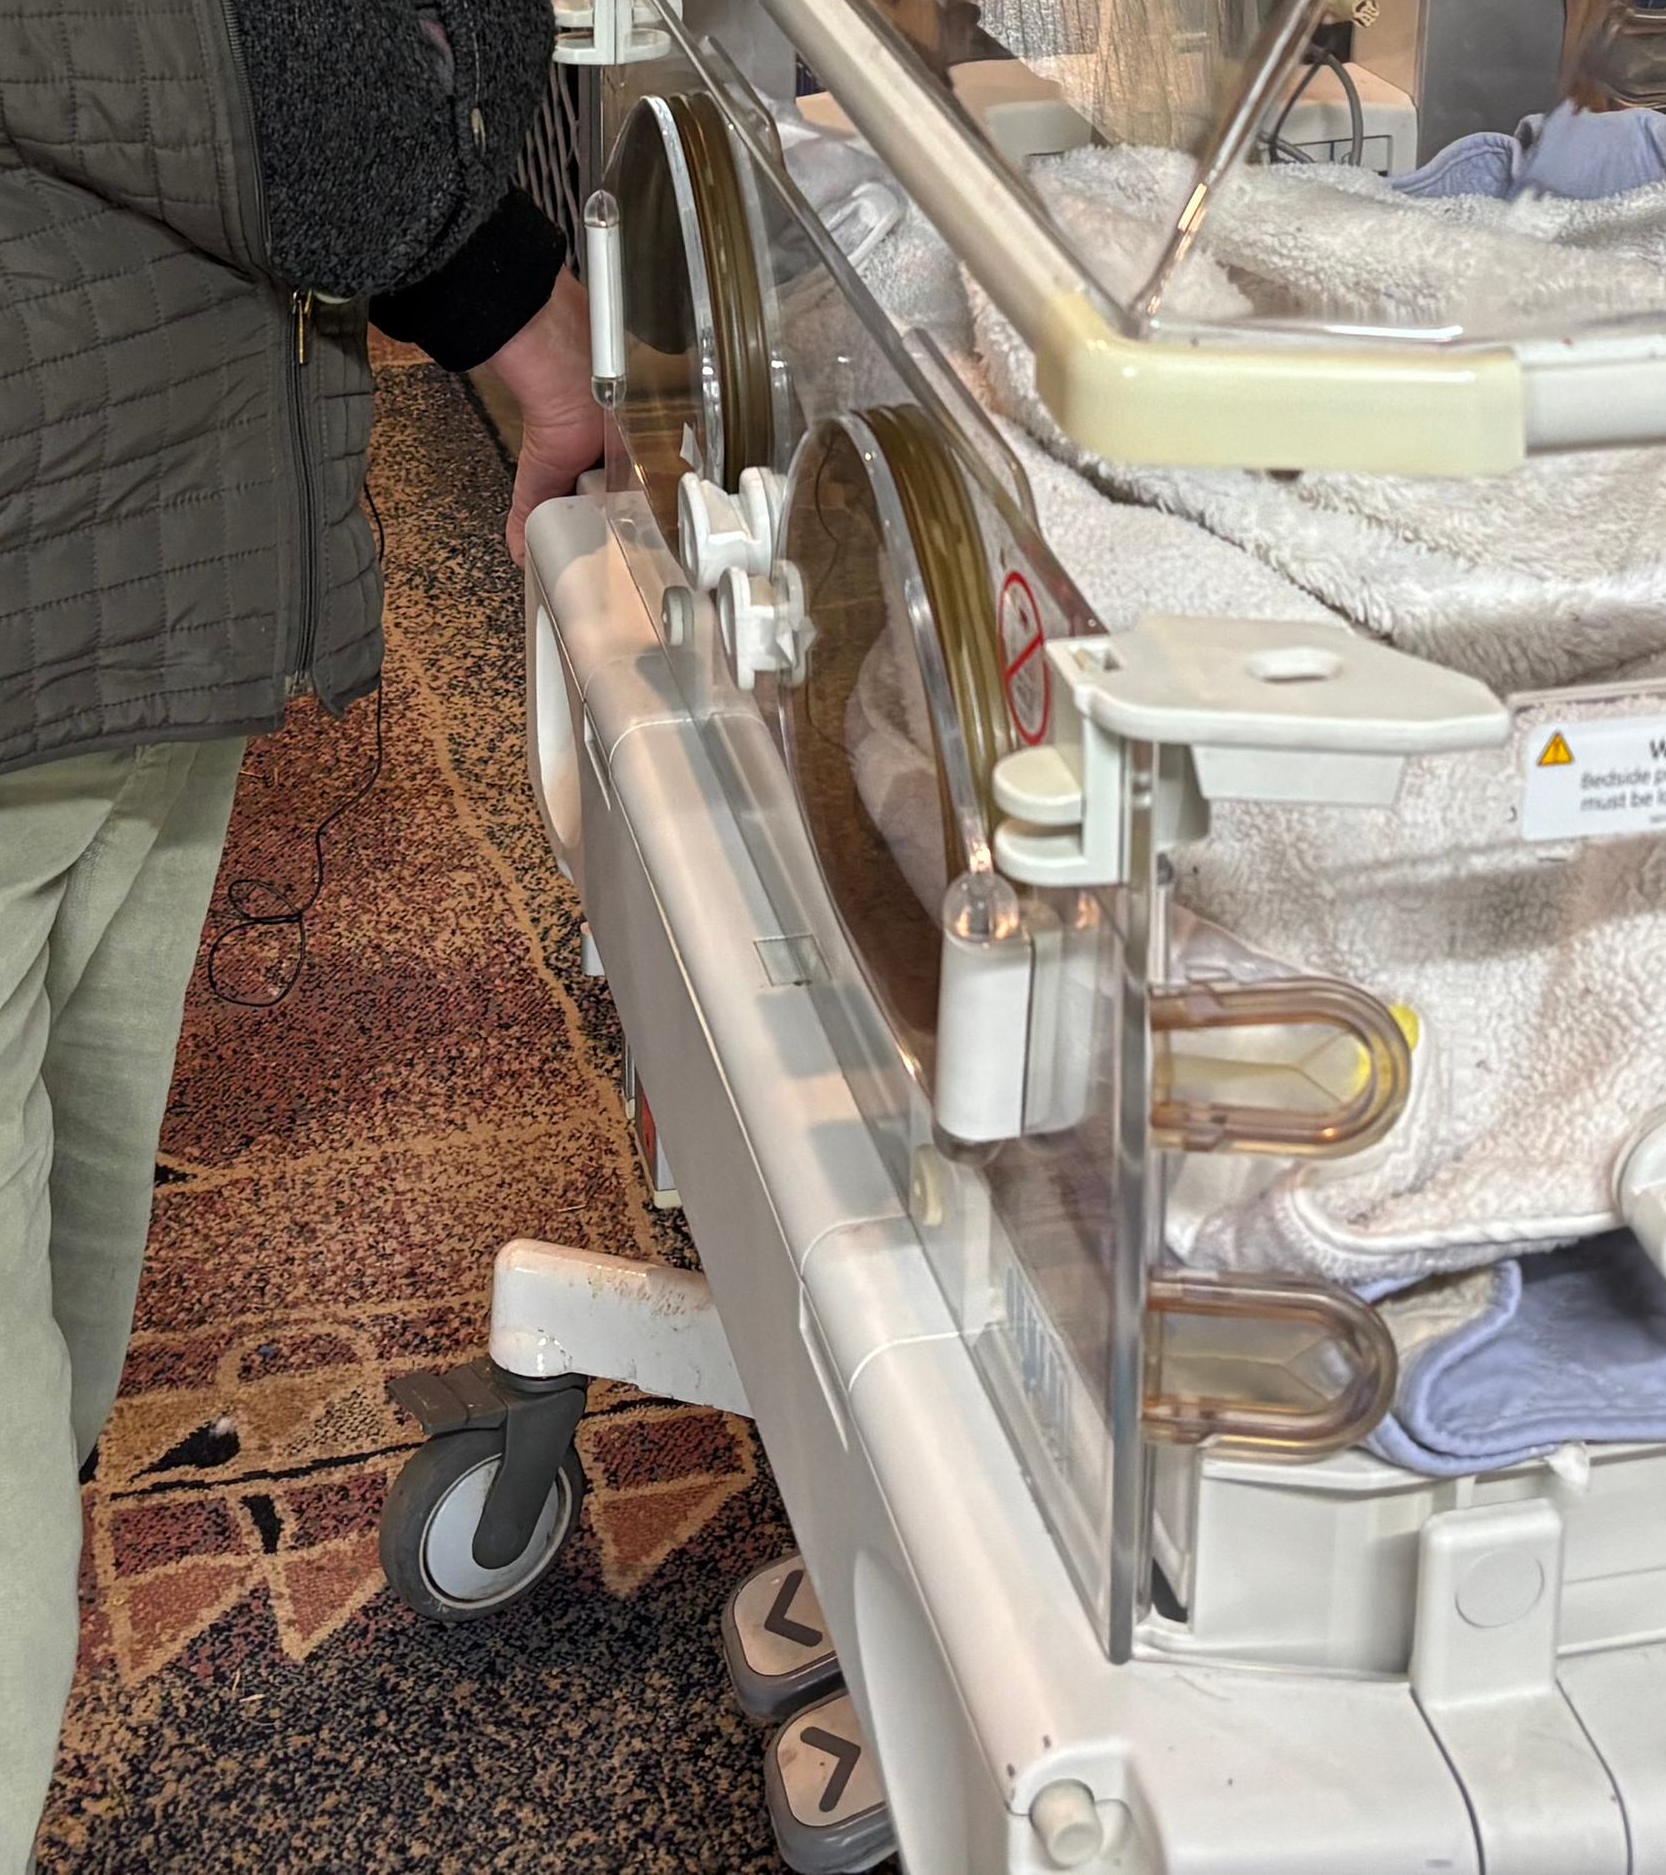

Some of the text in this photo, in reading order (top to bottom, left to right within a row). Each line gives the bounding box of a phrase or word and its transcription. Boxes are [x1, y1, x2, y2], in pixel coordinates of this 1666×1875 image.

[1581, 770, 1651, 790] Bedside
[1580, 793, 1626, 812] must
[1631, 790, 1653, 808] be
